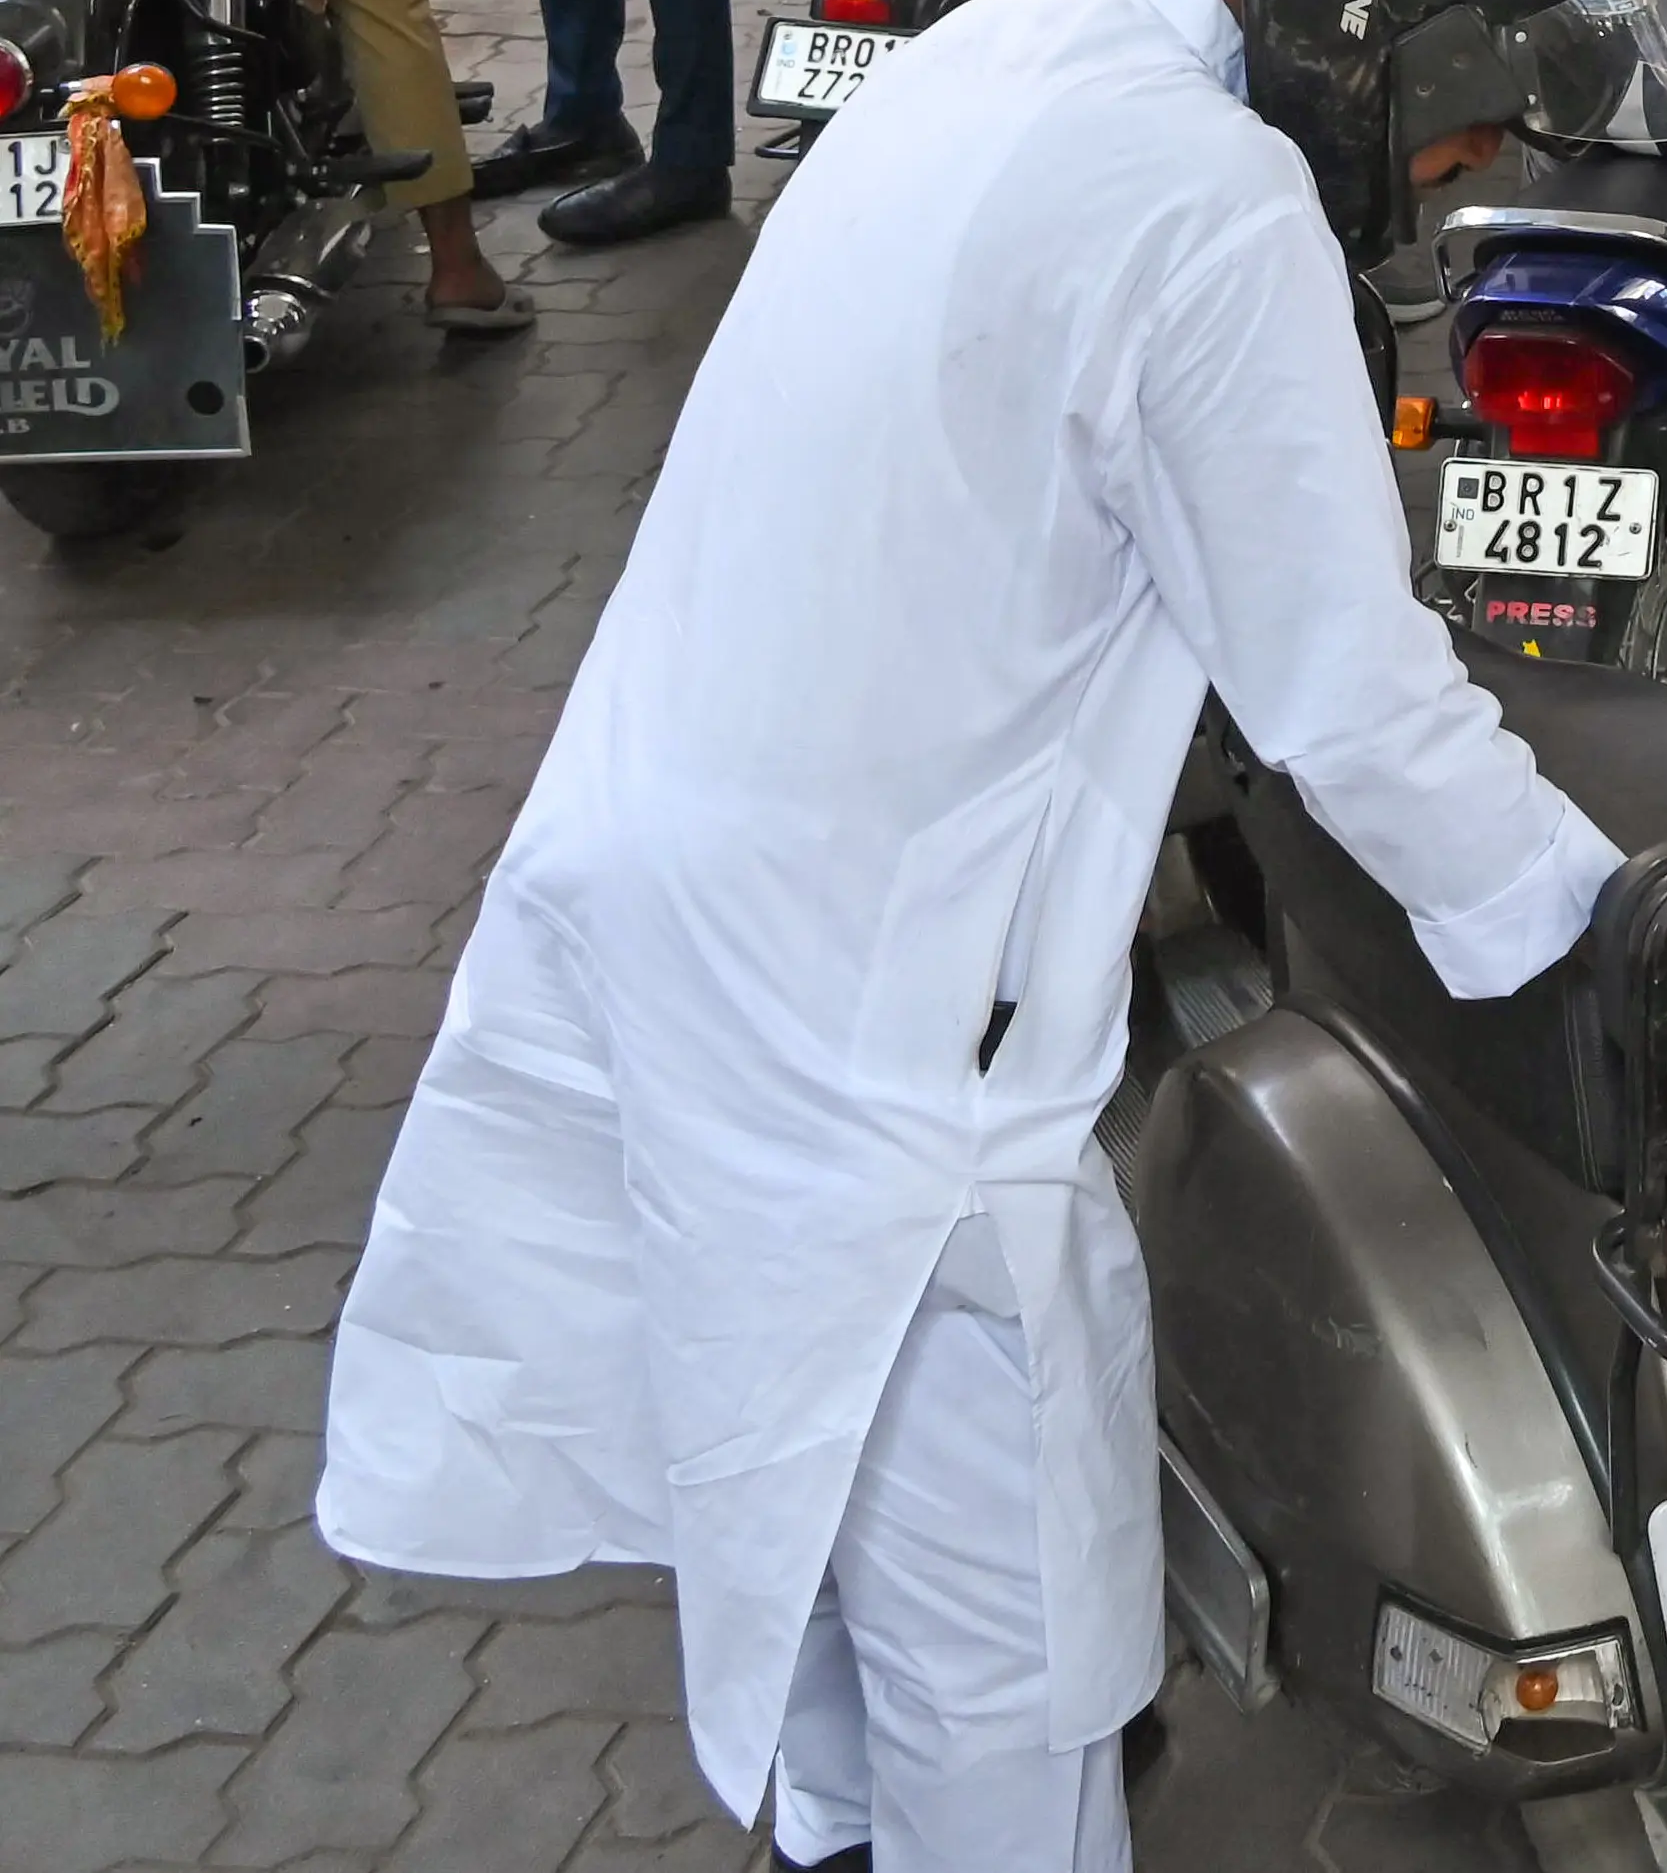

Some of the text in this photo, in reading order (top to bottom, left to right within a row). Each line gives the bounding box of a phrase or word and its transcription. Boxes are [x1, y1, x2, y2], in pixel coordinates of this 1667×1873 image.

[798, 69, 865, 102] Z72
[1451, 507, 1475, 521] IND
[1484, 519, 1604, 568] 4812
[1486, 600, 1597, 628] PRESS
